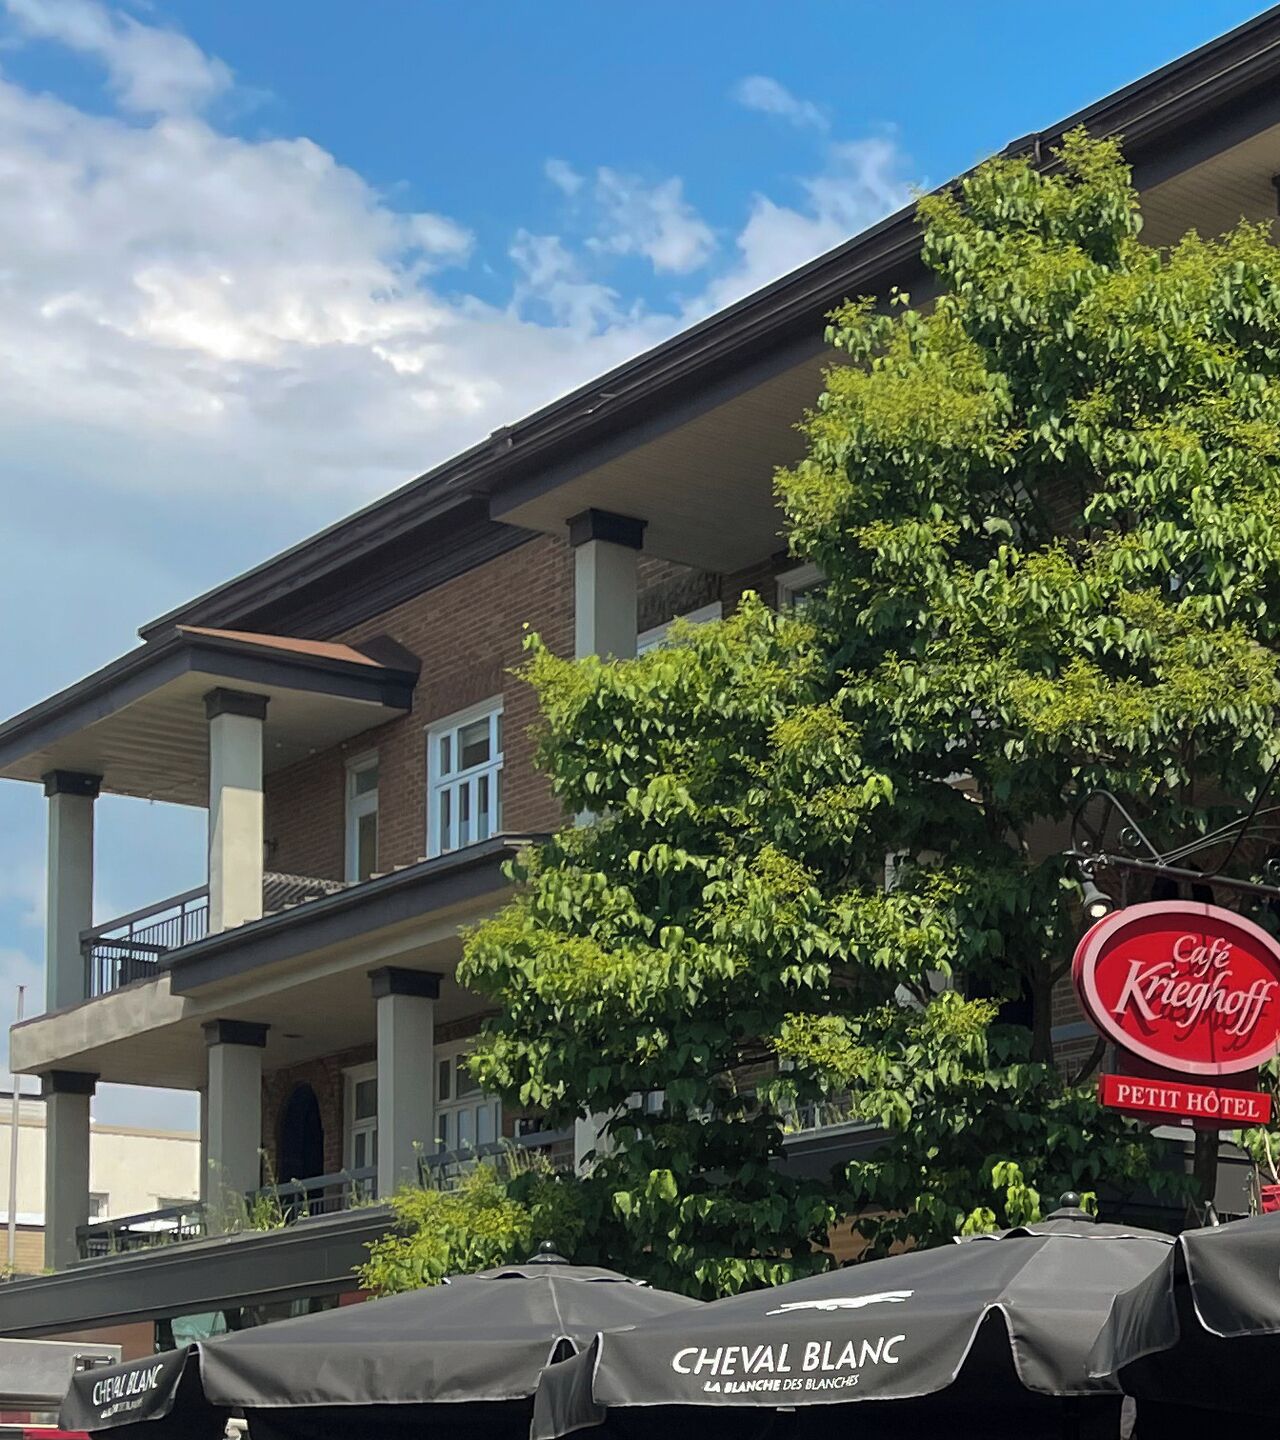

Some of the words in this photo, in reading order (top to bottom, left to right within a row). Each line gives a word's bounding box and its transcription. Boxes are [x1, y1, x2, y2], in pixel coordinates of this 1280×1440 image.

[1172, 934, 1234, 978] Café
[1111, 959, 1279, 1037] Krieghoff
[1117, 1083, 1182, 1111] PETIT
[1186, 1089, 1260, 1119] HÔTEL
[672, 1342, 792, 1376] CHEVAL
[801, 1334, 906, 1372] BLANC
[126, 1364, 164, 1396] BLANC
[703, 1380, 722, 1394] LA
[723, 1378, 783, 1394] BLANCHE
[783, 1377, 803, 1392] DES
[805, 1373, 860, 1392] BLANCHES
